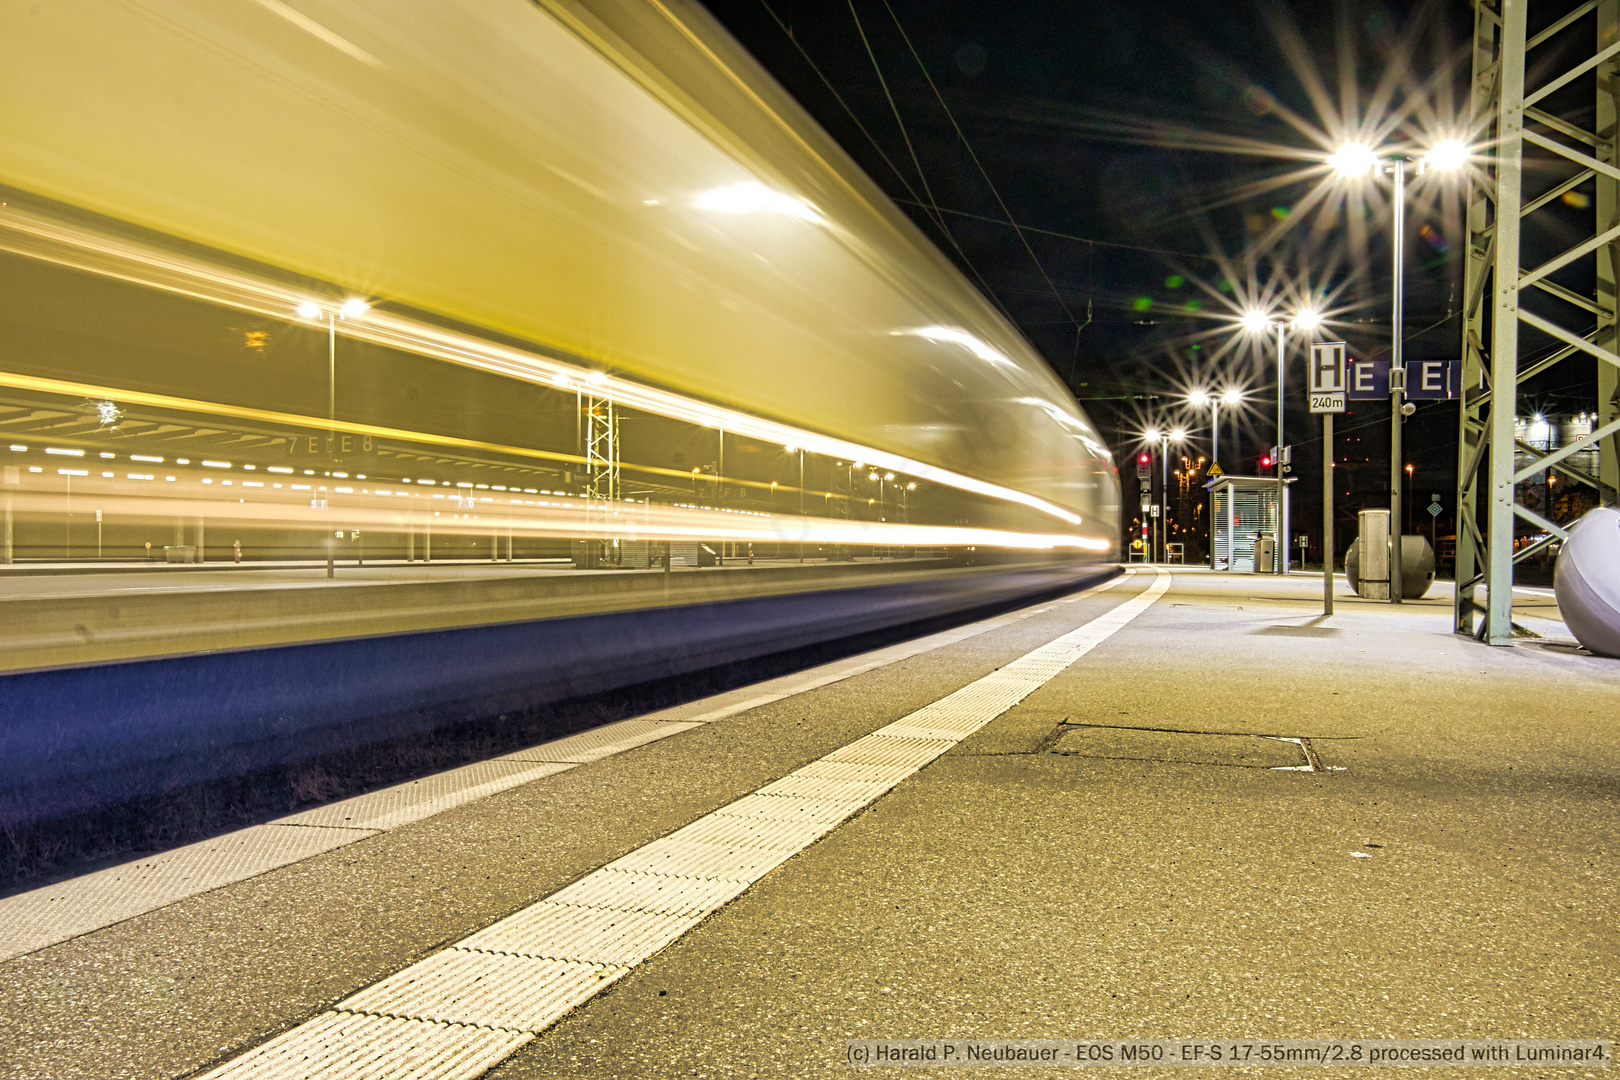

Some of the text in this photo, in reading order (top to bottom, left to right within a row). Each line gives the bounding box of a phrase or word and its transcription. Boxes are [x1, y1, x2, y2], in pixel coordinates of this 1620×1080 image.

[1314, 348, 1341, 388] H
[1355, 363, 1374, 390] E
[1422, 362, 1442, 390] E
[1312, 397, 1343, 408] 240m
[288, 436, 318, 454] 7 E
[342, 436, 372, 452] E 8
